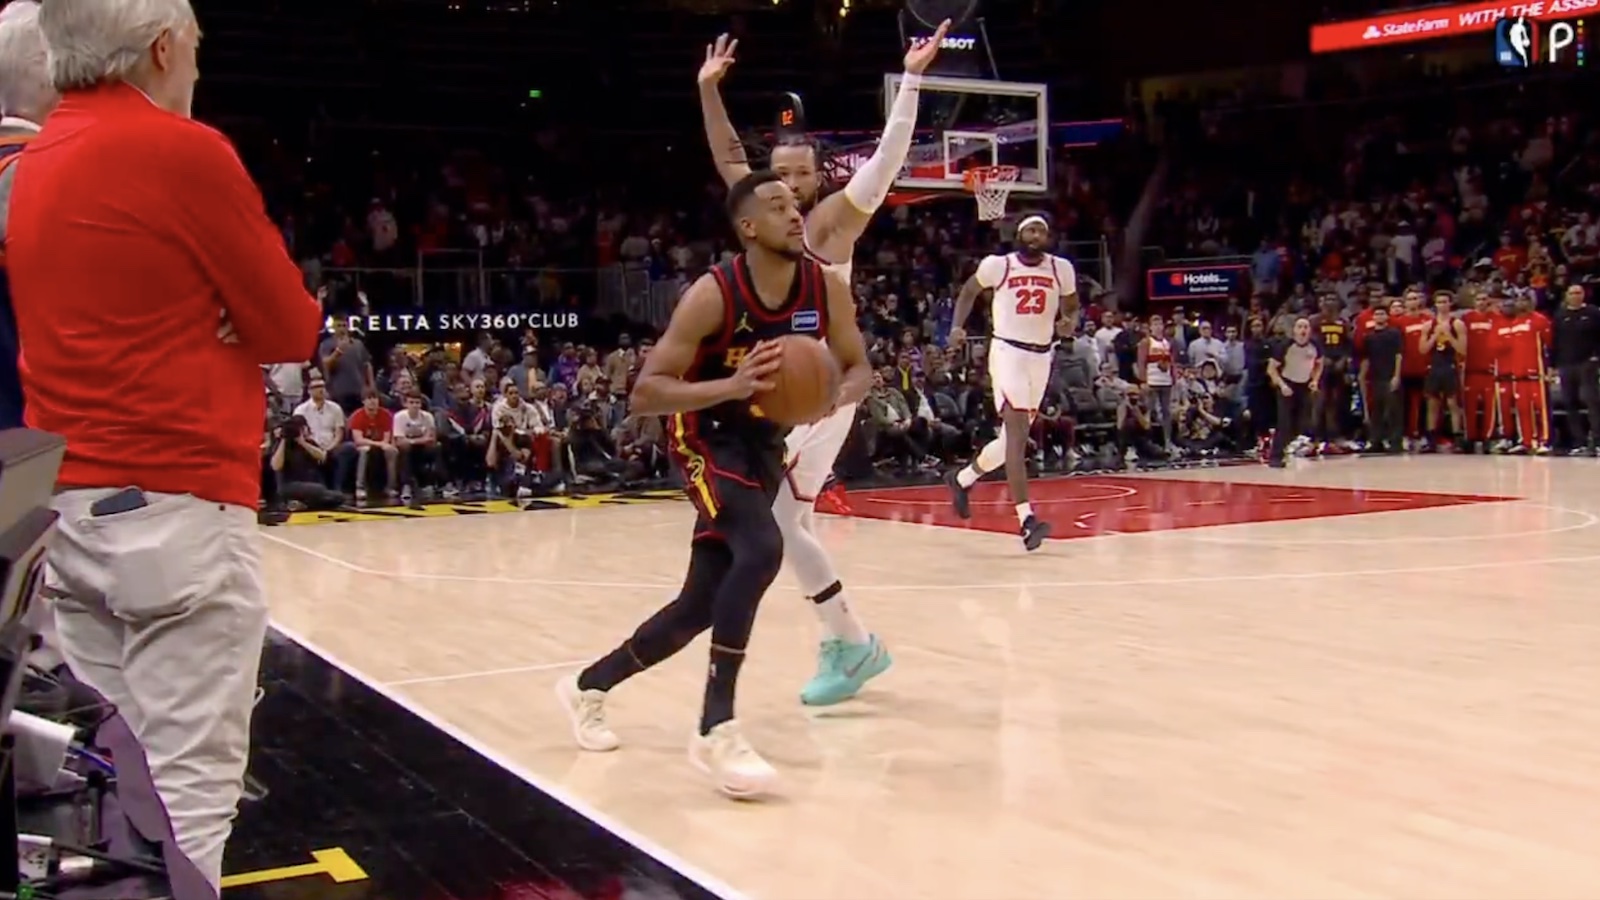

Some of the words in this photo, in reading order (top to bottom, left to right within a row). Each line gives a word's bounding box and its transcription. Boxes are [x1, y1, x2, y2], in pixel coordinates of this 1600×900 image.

[1458, 7, 1506, 27] WITH
[1511, 2, 1545, 17] THE
[1015, 289, 1047, 315] 23
[347, 314, 431, 332] DELTA
